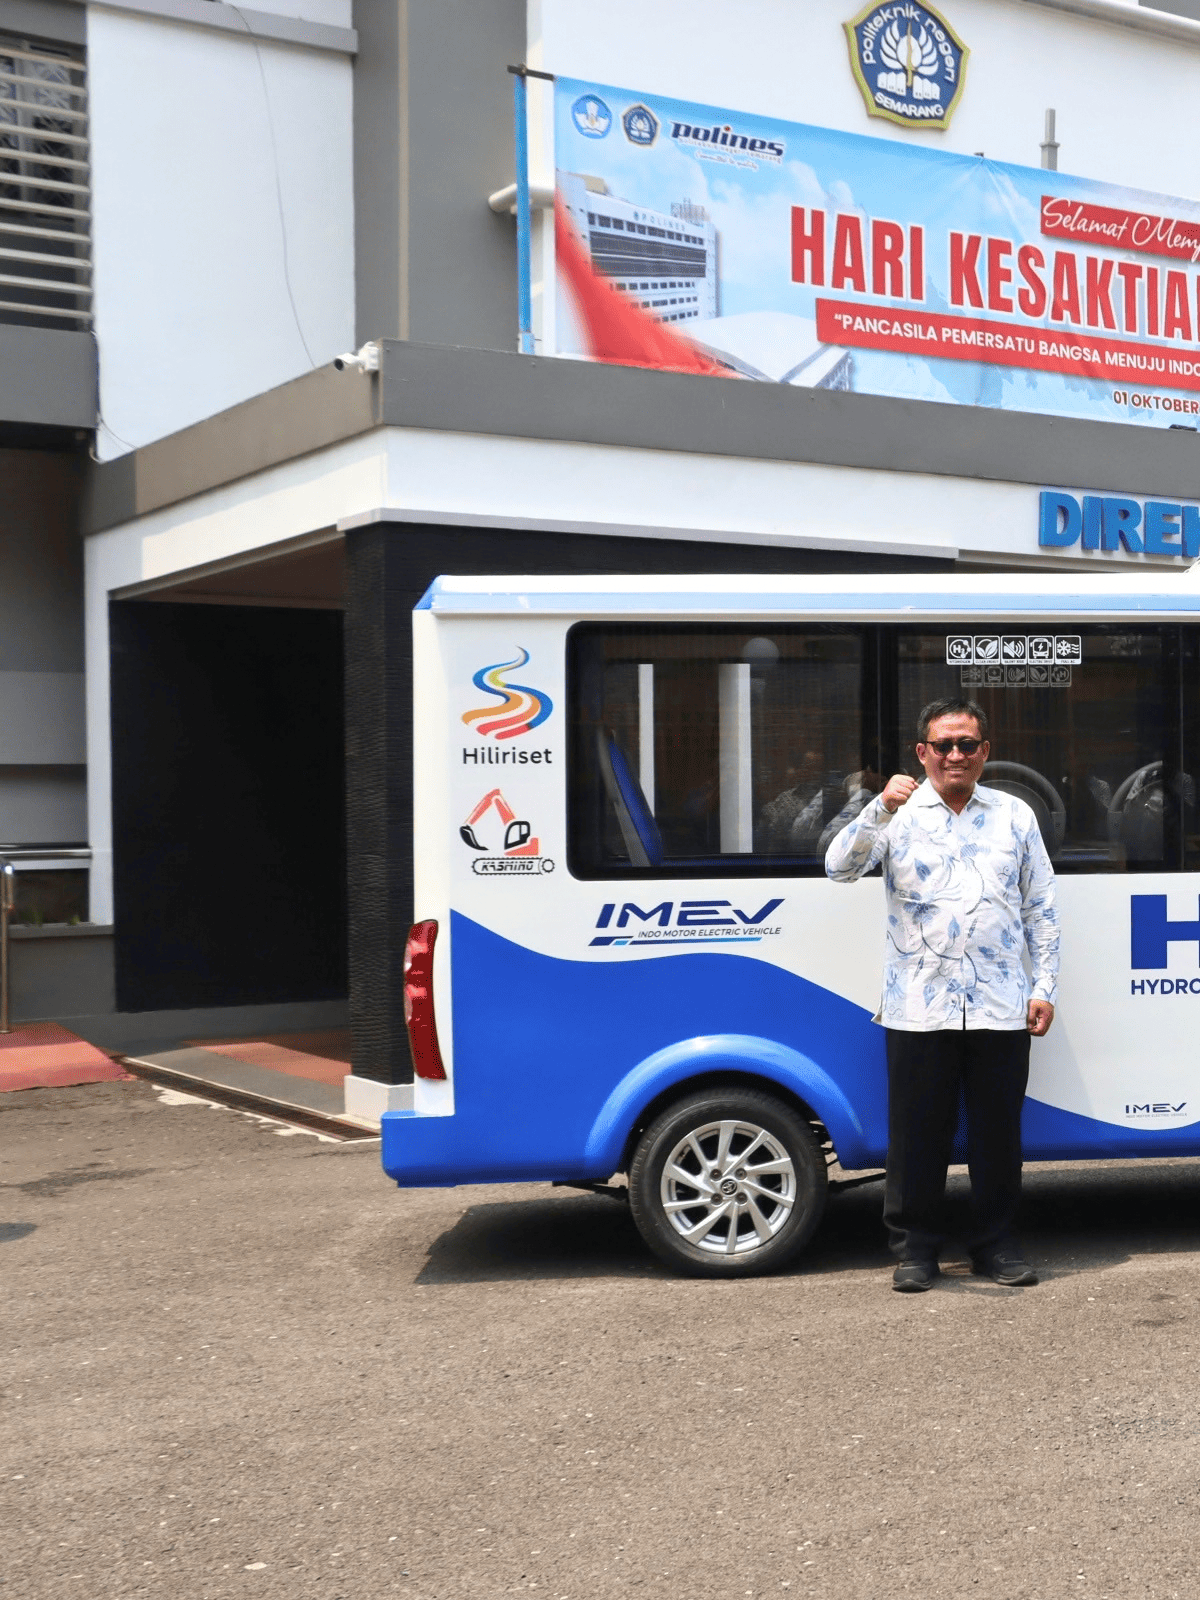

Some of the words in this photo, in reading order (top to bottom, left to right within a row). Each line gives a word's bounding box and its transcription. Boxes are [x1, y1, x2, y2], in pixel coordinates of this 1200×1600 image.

[862, 3, 921, 64] politeknik
[925, 18, 955, 82] negeri
[875, 92, 945, 118] SEMARANG
[670, 121, 784, 157] polines
[1043, 198, 1128, 241] Selamat
[791, 205, 924, 301] HARI
[834, 313, 938, 342] “PANCASILA
[941, 327, 1035, 354] PEMERSATU
[1039, 341, 1101, 364] BANGSA
[1105, 351, 1165, 372] MENUJU
[1113, 390, 1128, 405] 01
[1131, 393, 1199, 414] OKTOBER
[463, 747, 552, 764] Hiliriset
[595, 898, 786, 928] IMEV
[638, 930, 661, 938] INDO
[663, 929, 697, 937] MOTOR
[698, 928, 741, 936] ELECTRIC
[742, 927, 782, 935] VEHICLE
[1125, 1102, 1187, 1114] IMEV
